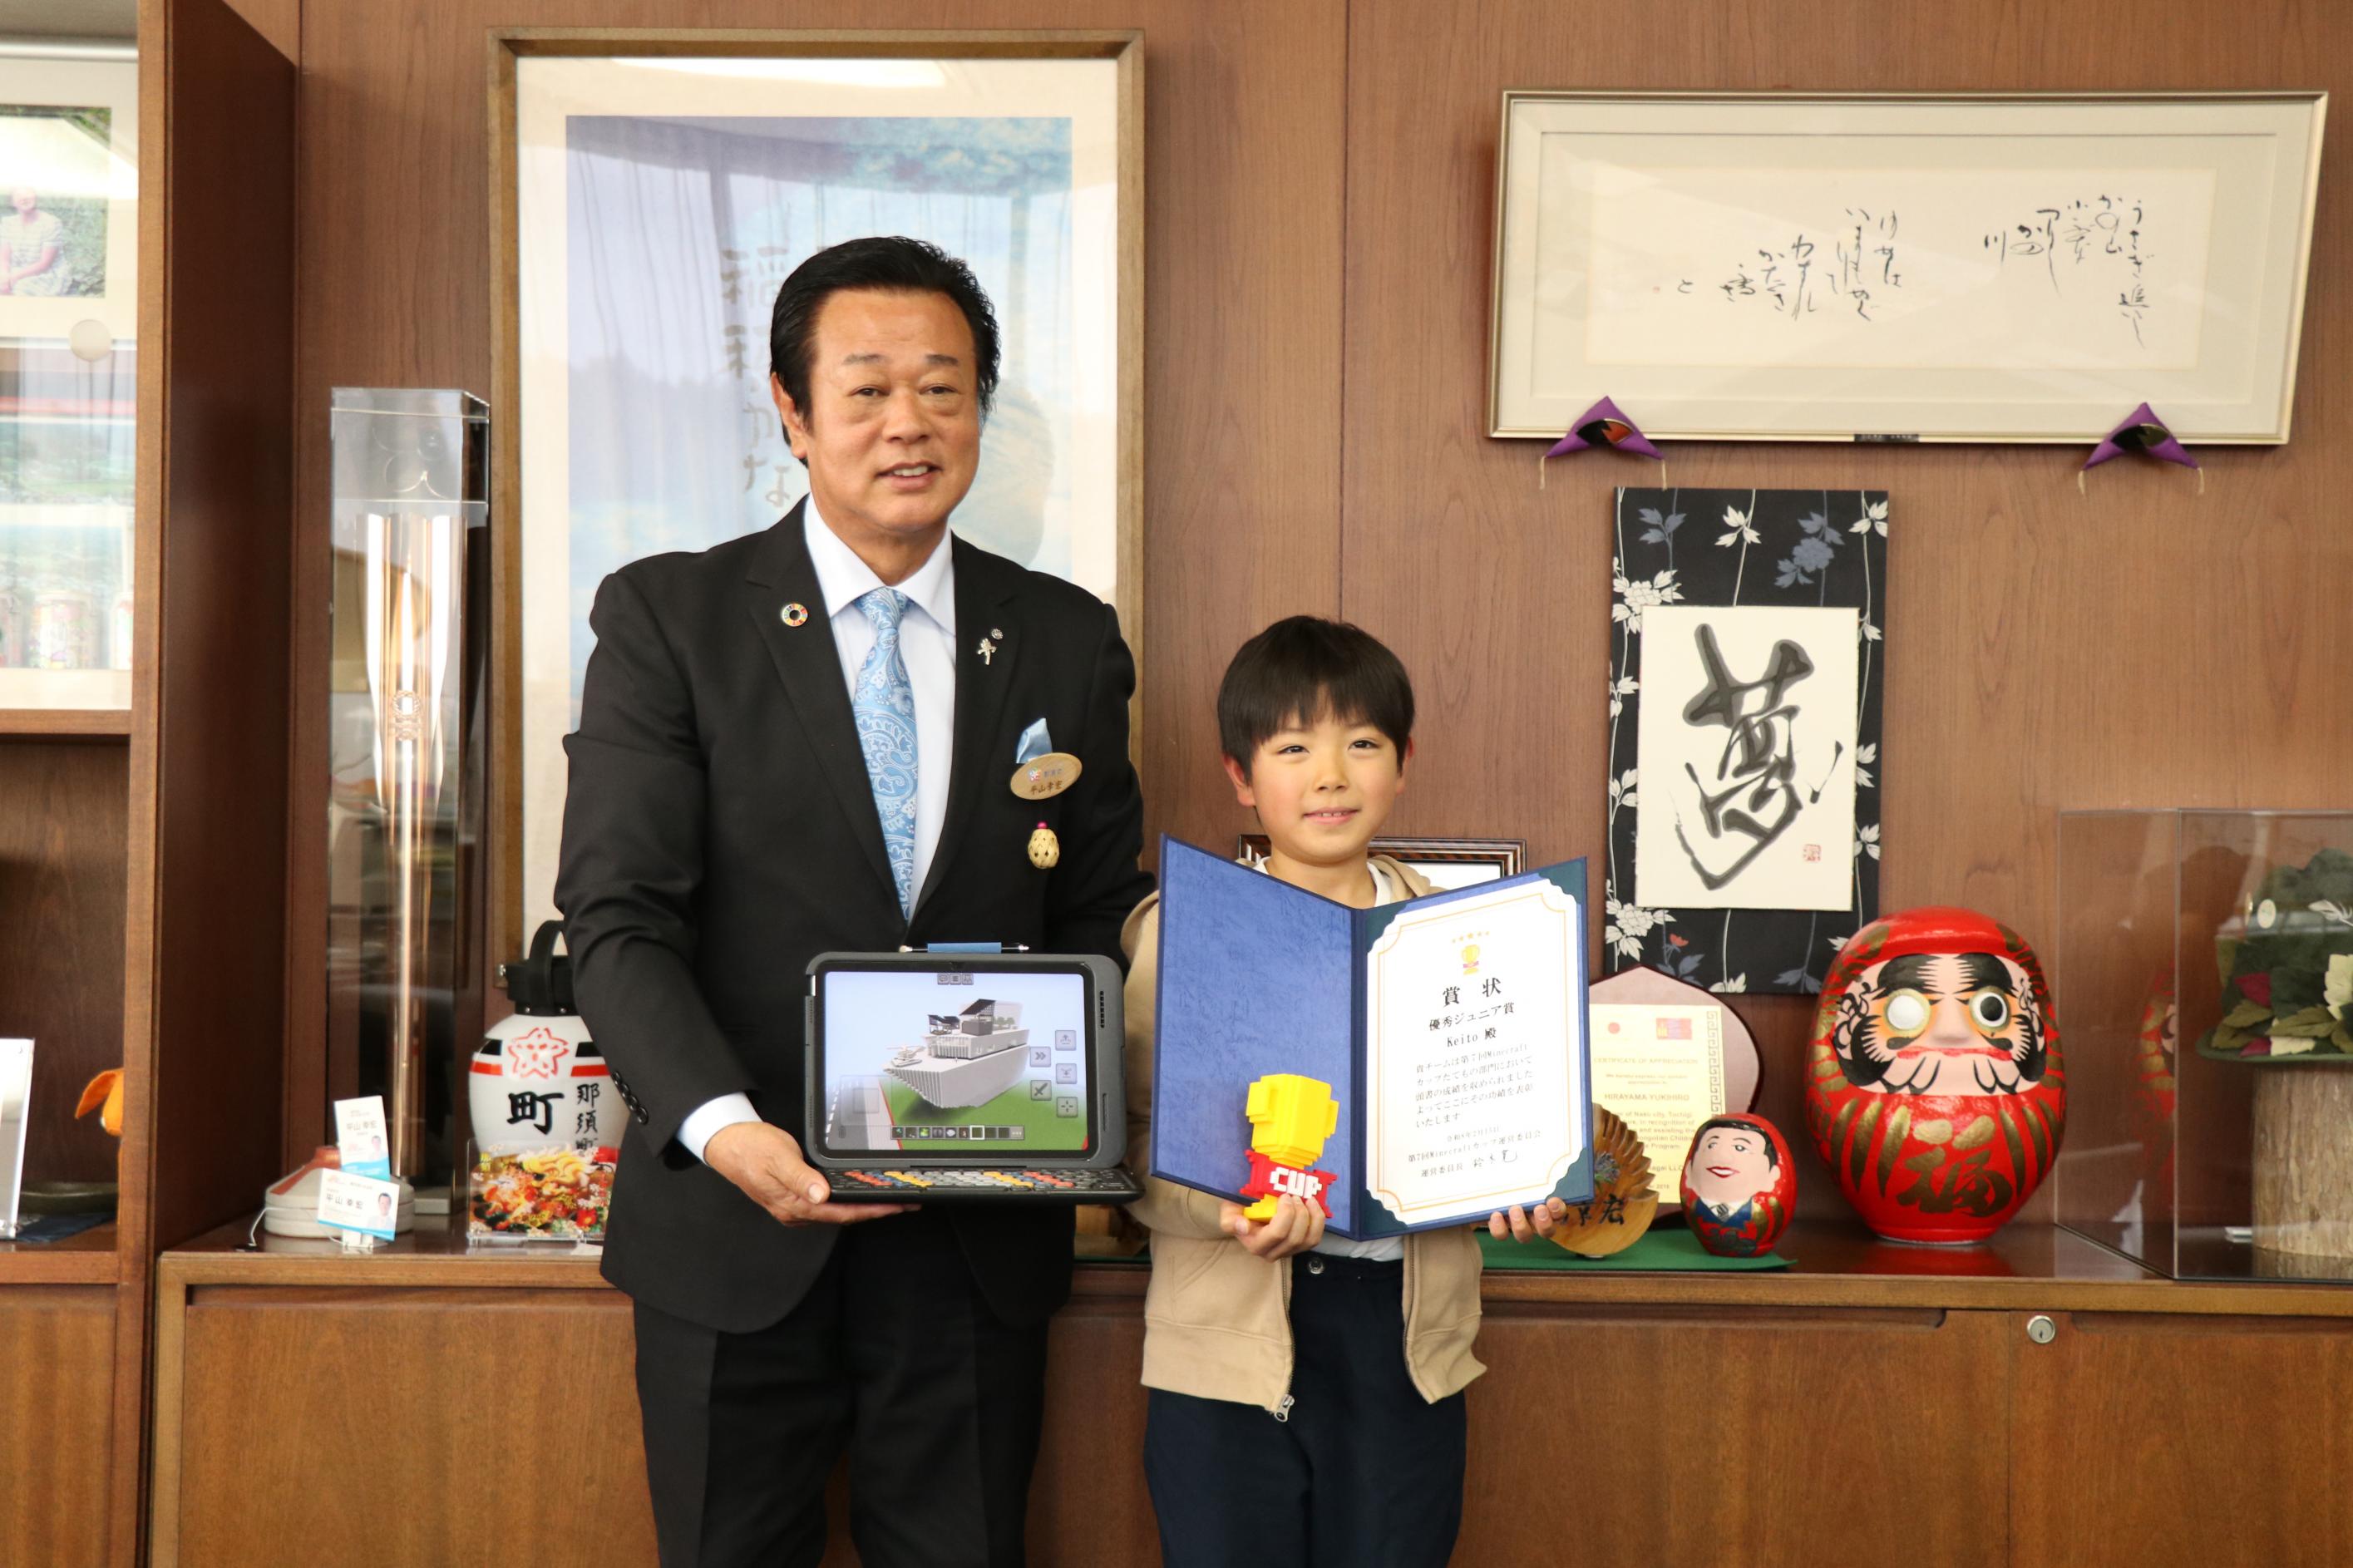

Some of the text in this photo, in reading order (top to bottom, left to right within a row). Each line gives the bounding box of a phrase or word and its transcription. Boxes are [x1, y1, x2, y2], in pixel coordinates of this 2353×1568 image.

[1428, 1001, 1515, 1031] 優秀ジュニア賞
[1447, 1027, 1497, 1048] Keito 殿
[1604, 1093, 1690, 1102] HIRAYAMA YUKIHIRO
[506, 1091, 565, 1136] 町
[1416, 1112, 1461, 1128] いたします
[1269, 1166, 1322, 1200] CUP
[1896, 1146, 2014, 1217] 福
